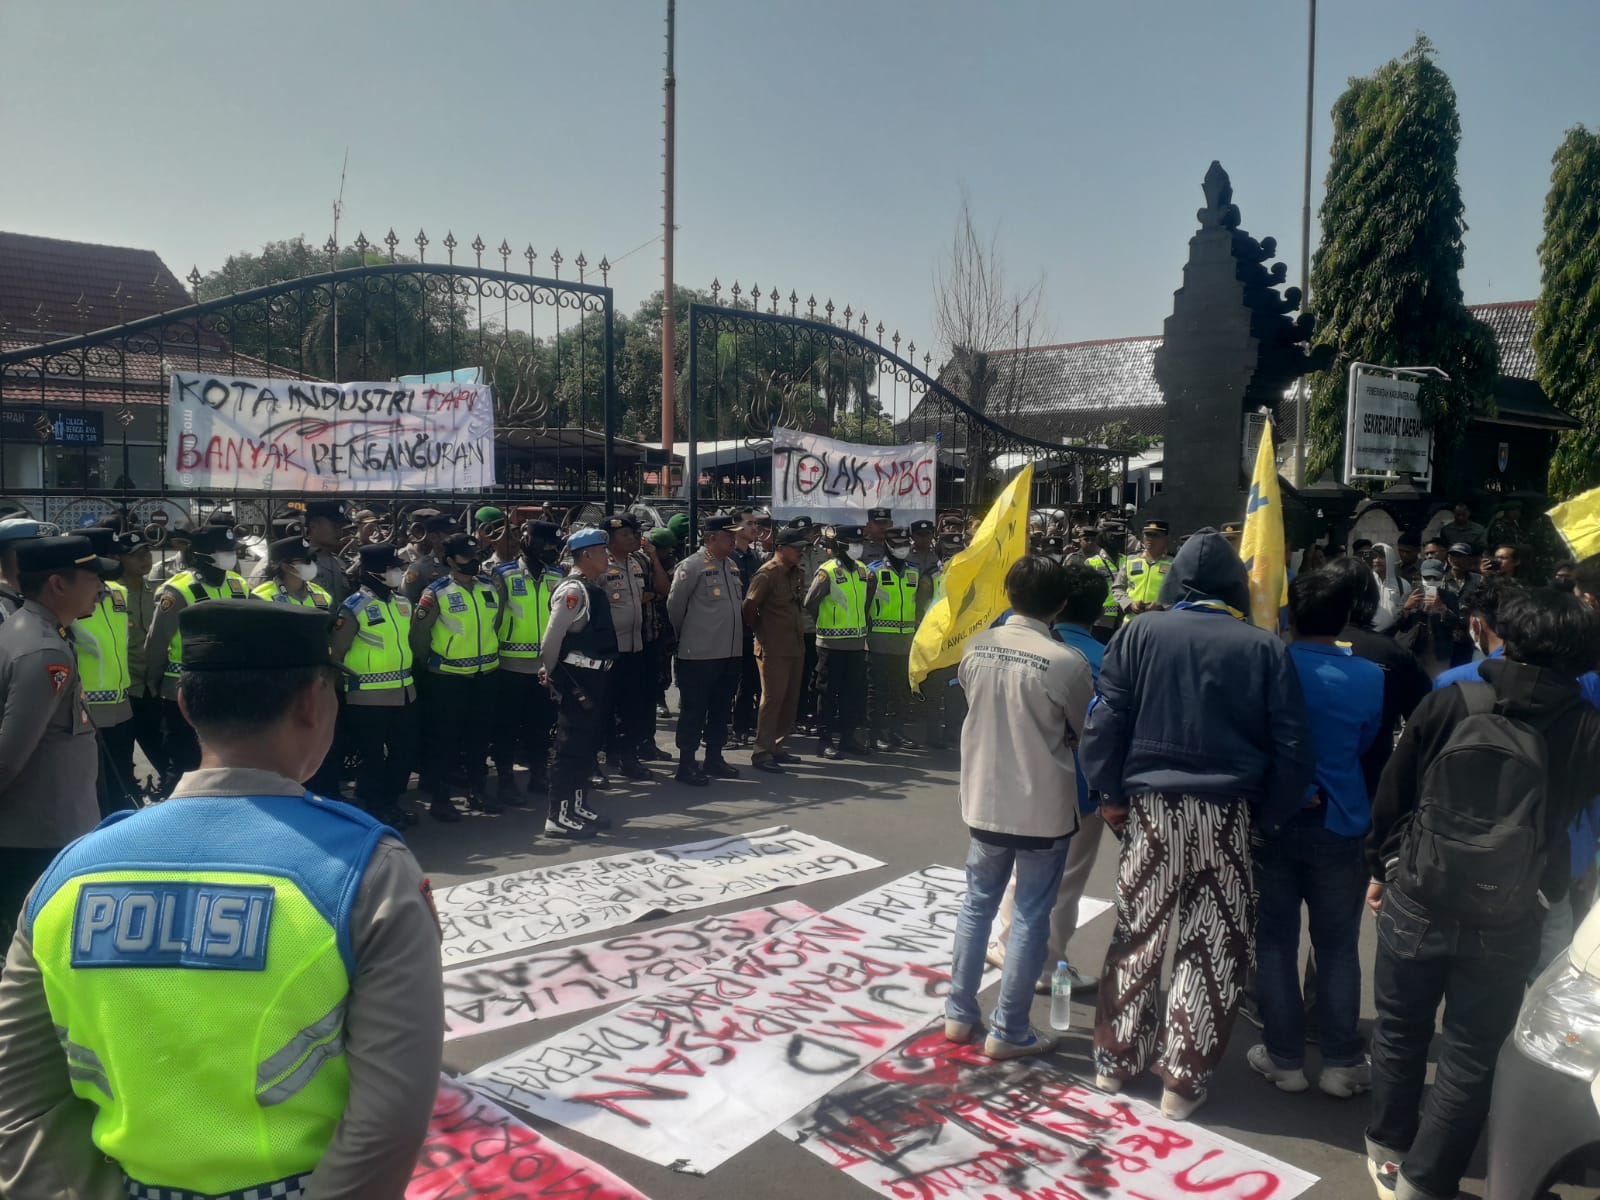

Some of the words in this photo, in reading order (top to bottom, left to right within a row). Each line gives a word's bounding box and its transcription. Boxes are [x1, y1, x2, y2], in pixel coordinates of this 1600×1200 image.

[176, 375, 279, 416] KOTA
[288, 384, 416, 413] INDUSTRI
[1363, 413, 1400, 437] SEKRETARIAT
[176, 432, 306, 472] BANYAK
[774, 446, 868, 501] TOLAK
[873, 460, 933, 498] MBG
[81, 891, 264, 959] POLISI
[617, 914, 867, 1046] MASYARAKAT
[561, 950, 903, 1127] PERAMPASAN
[786, 957, 956, 1075] PJMD
[467, 1026, 649, 1109] DAERAH
